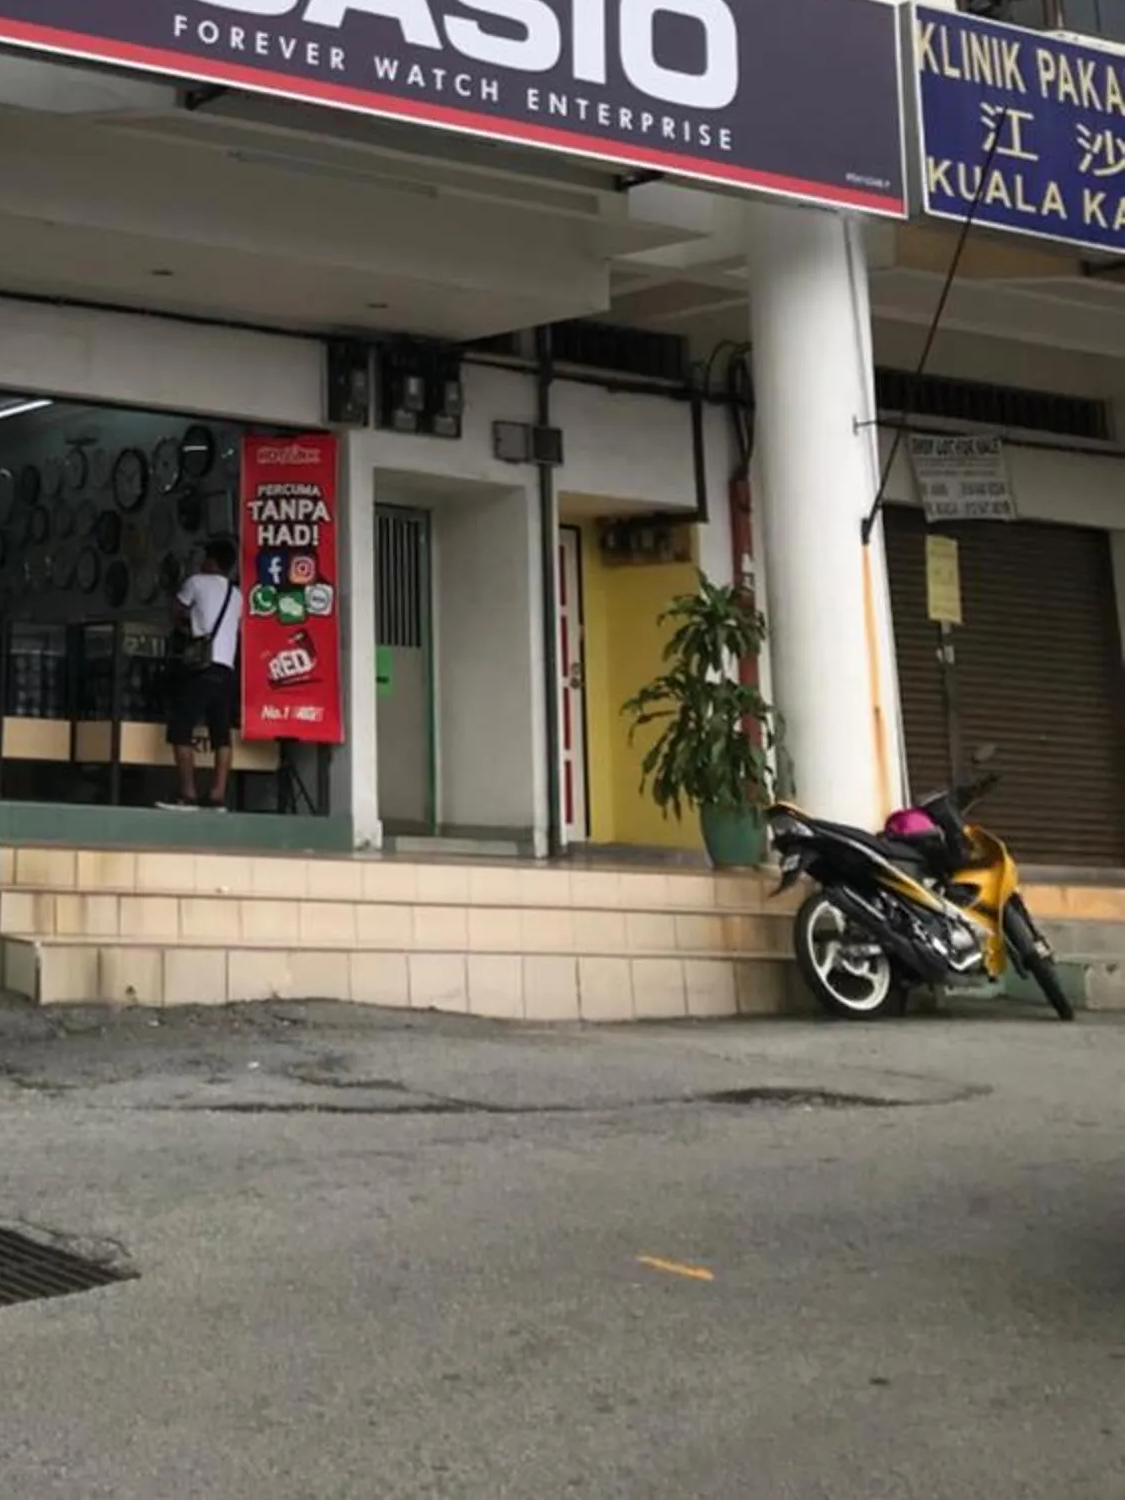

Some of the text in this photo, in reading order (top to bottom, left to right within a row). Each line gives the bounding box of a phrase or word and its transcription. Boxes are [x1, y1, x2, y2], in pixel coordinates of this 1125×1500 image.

[915, 21, 1027, 95] KLINIK
[173, 14, 734, 152] FOREVER WATCH ENTERPRISE
[927, 156, 1068, 220] KUALA
[258, 484, 322, 498] PERCUMA
[247, 499, 331, 523] TANPA
[258, 524, 318, 546] HAD!
[268, 648, 316, 681] RED
